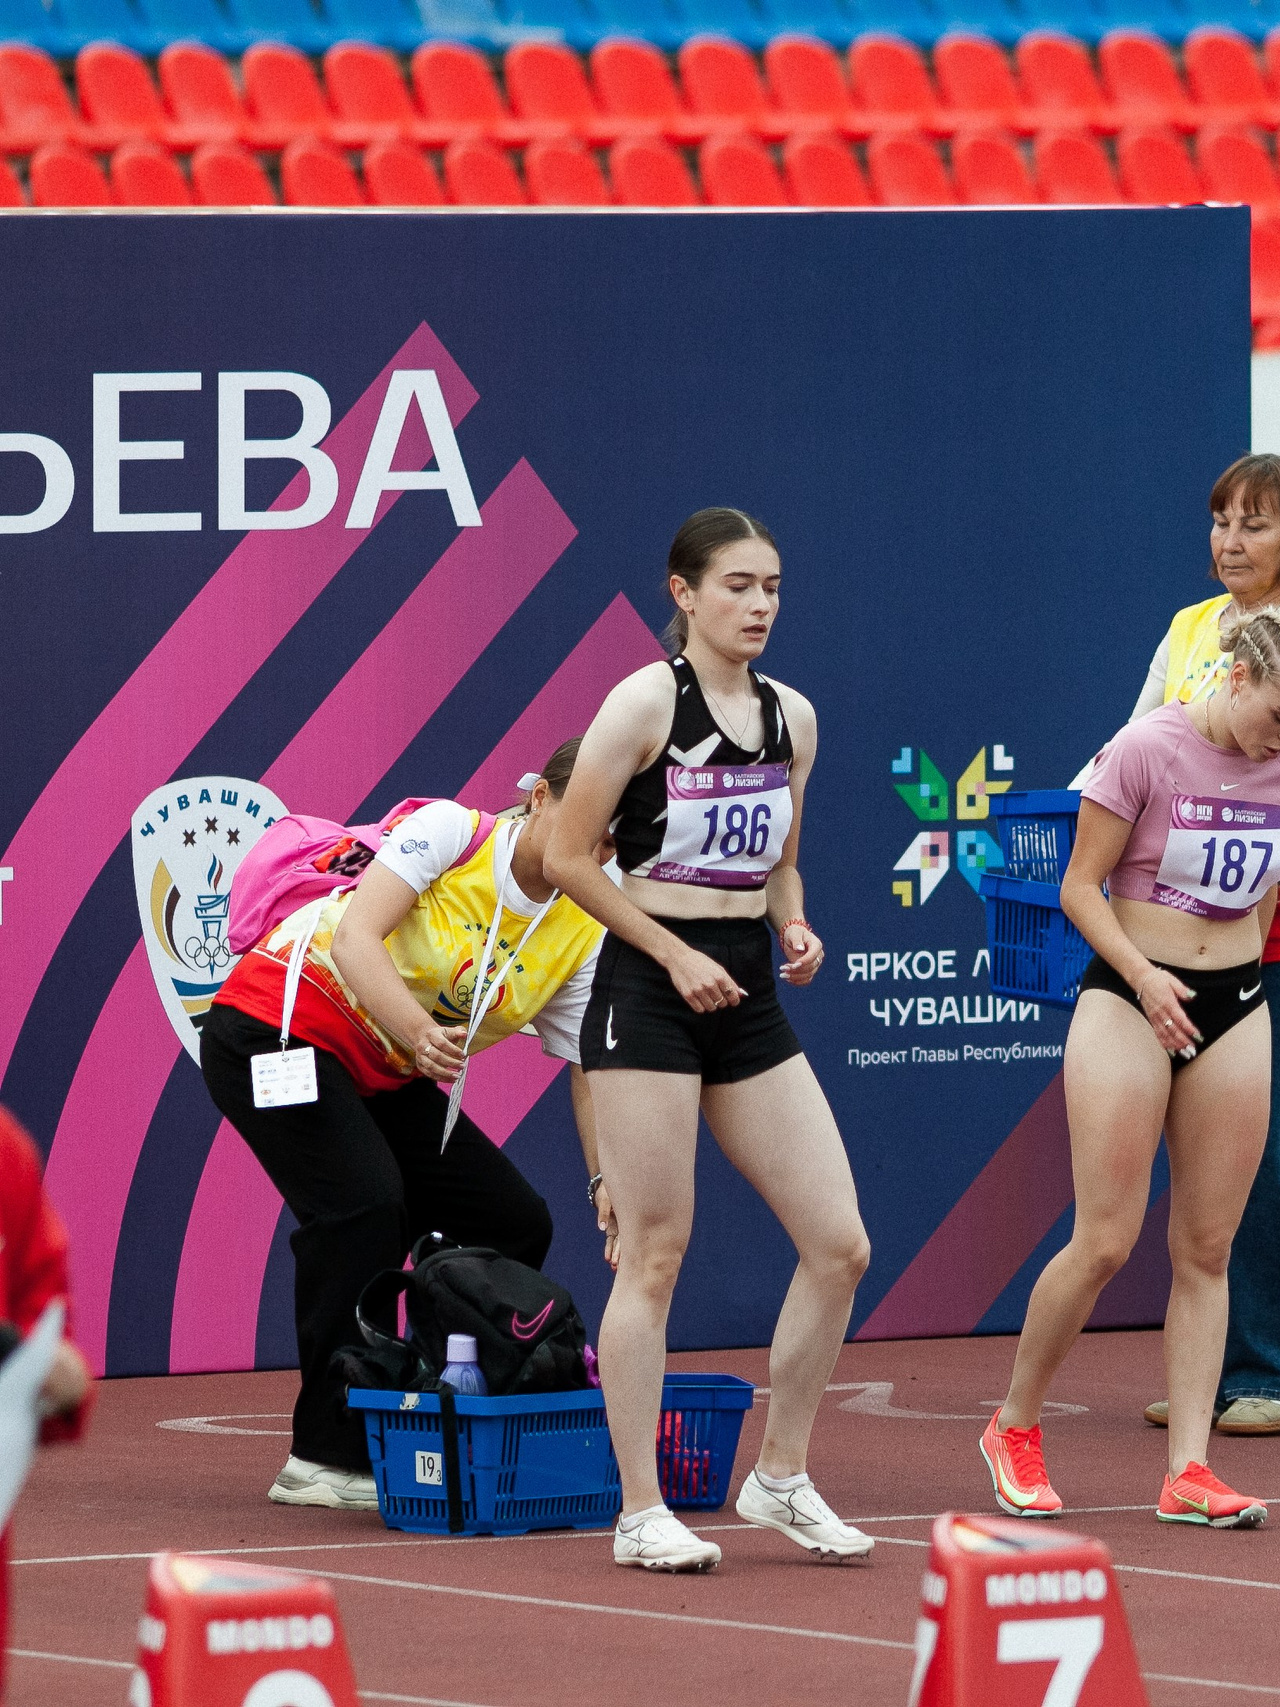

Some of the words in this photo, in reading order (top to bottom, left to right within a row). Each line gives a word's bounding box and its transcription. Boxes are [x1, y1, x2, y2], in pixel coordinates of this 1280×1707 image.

[700, 803, 771, 859] 186
[1200, 837, 1273, 894] 187
[847, 950, 957, 981] ЯРКОЕ
[869, 995, 1040, 1027] ЧУВАШИИ
[848, 1049, 907, 1068] Проект
[911, 1046, 959, 1063] Главы
[963, 1042, 1062, 1064] Республики
[985, 1568, 1107, 1608] MONDO
[206, 1613, 335, 1655] MONDO
[996, 1615, 1105, 1707] 7
